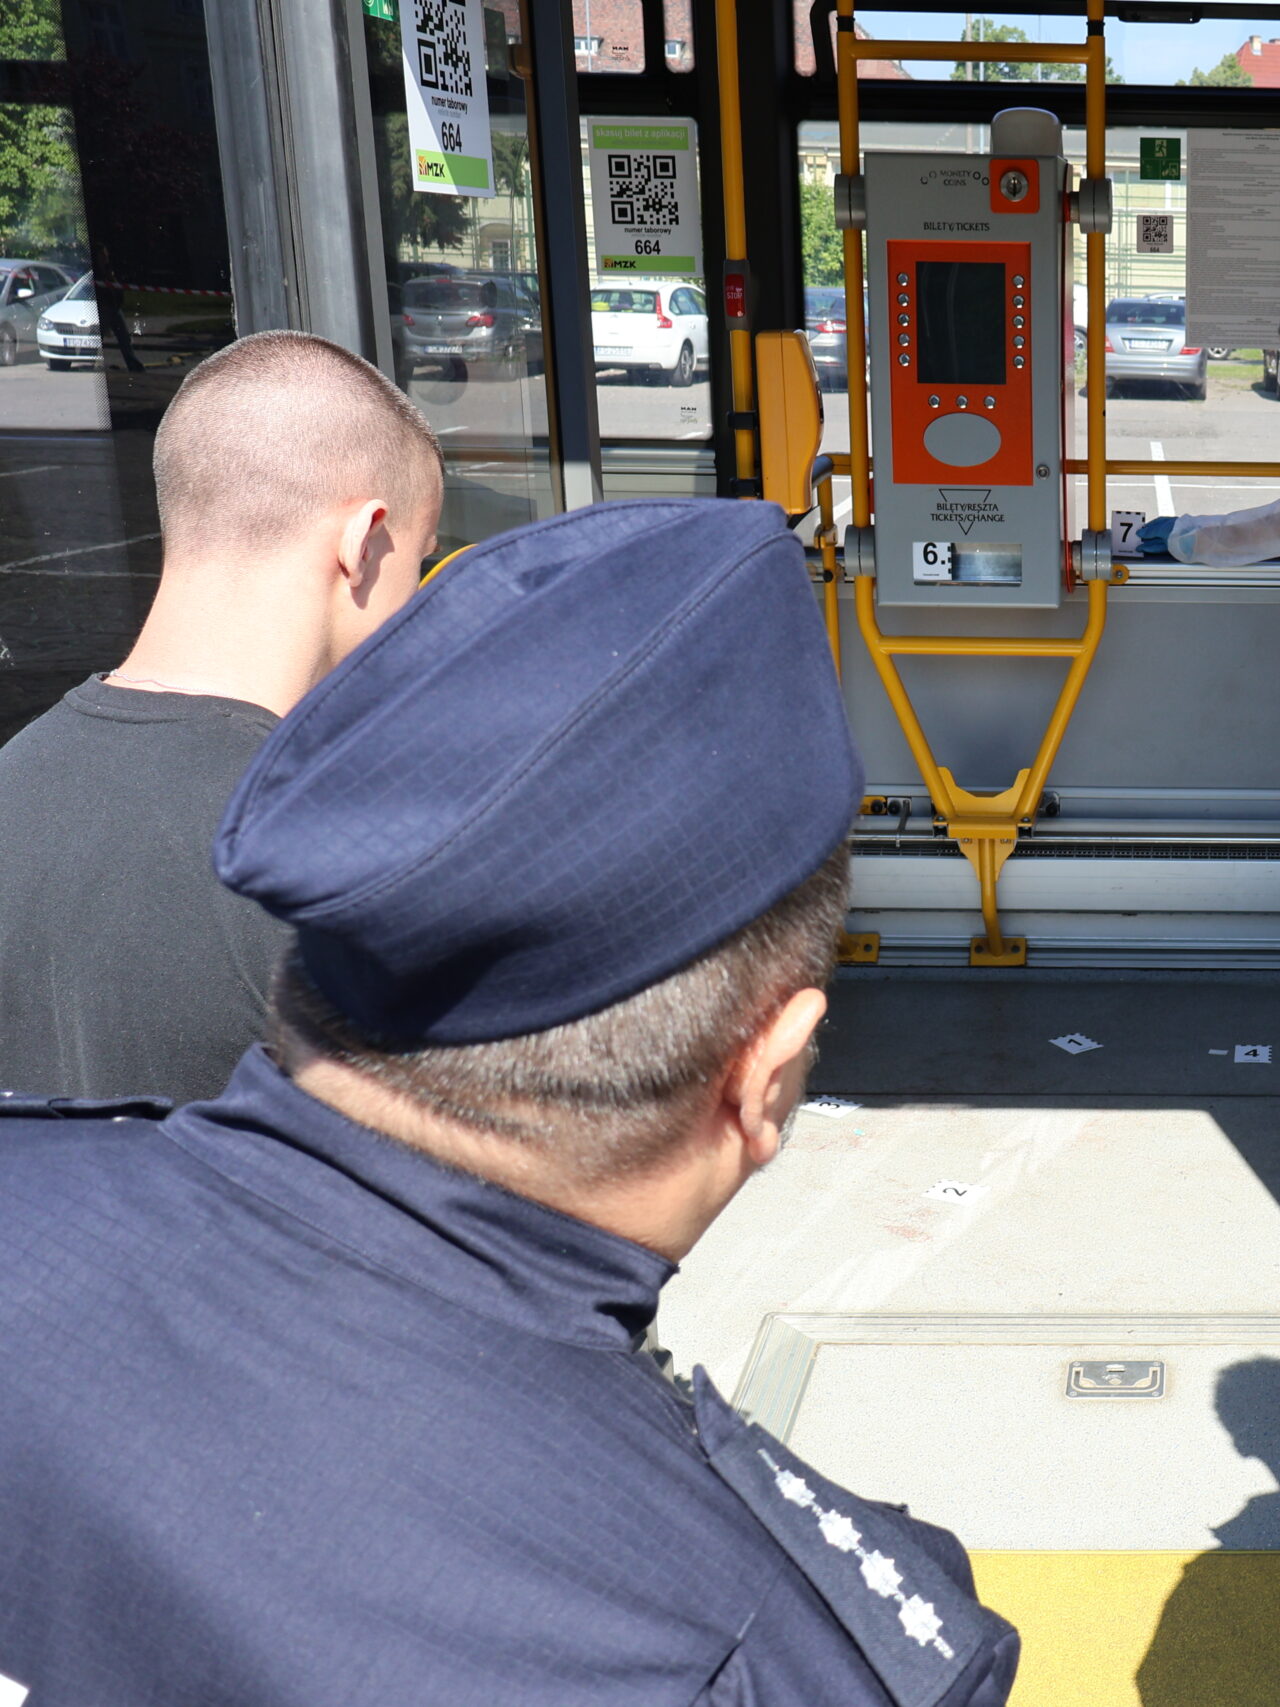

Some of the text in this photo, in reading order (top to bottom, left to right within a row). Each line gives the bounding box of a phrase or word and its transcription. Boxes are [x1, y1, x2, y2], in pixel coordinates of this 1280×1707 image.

[431, 96, 447, 109] numer
[447, 98, 468, 115] taborowy
[441, 121, 462, 152] 664
[625, 129, 642, 137] bilet
[651, 129, 685, 139] aplikacji
[427, 161, 445, 178] MZK
[940, 170, 971, 178] MONETY
[644, 226, 671, 235] taborowy
[635, 239, 661, 255] 664
[614, 260, 636, 269] MZK
[936, 503, 999, 513] BILETY/RESZTA
[930, 513, 1005, 522] TICKETS/CHANGE
[1120, 522, 1133, 543] 7
[1244, 1048, 1260, 1058] 4
[819, 1101, 840, 1110] 3
[942, 1186, 967, 1197] 2
